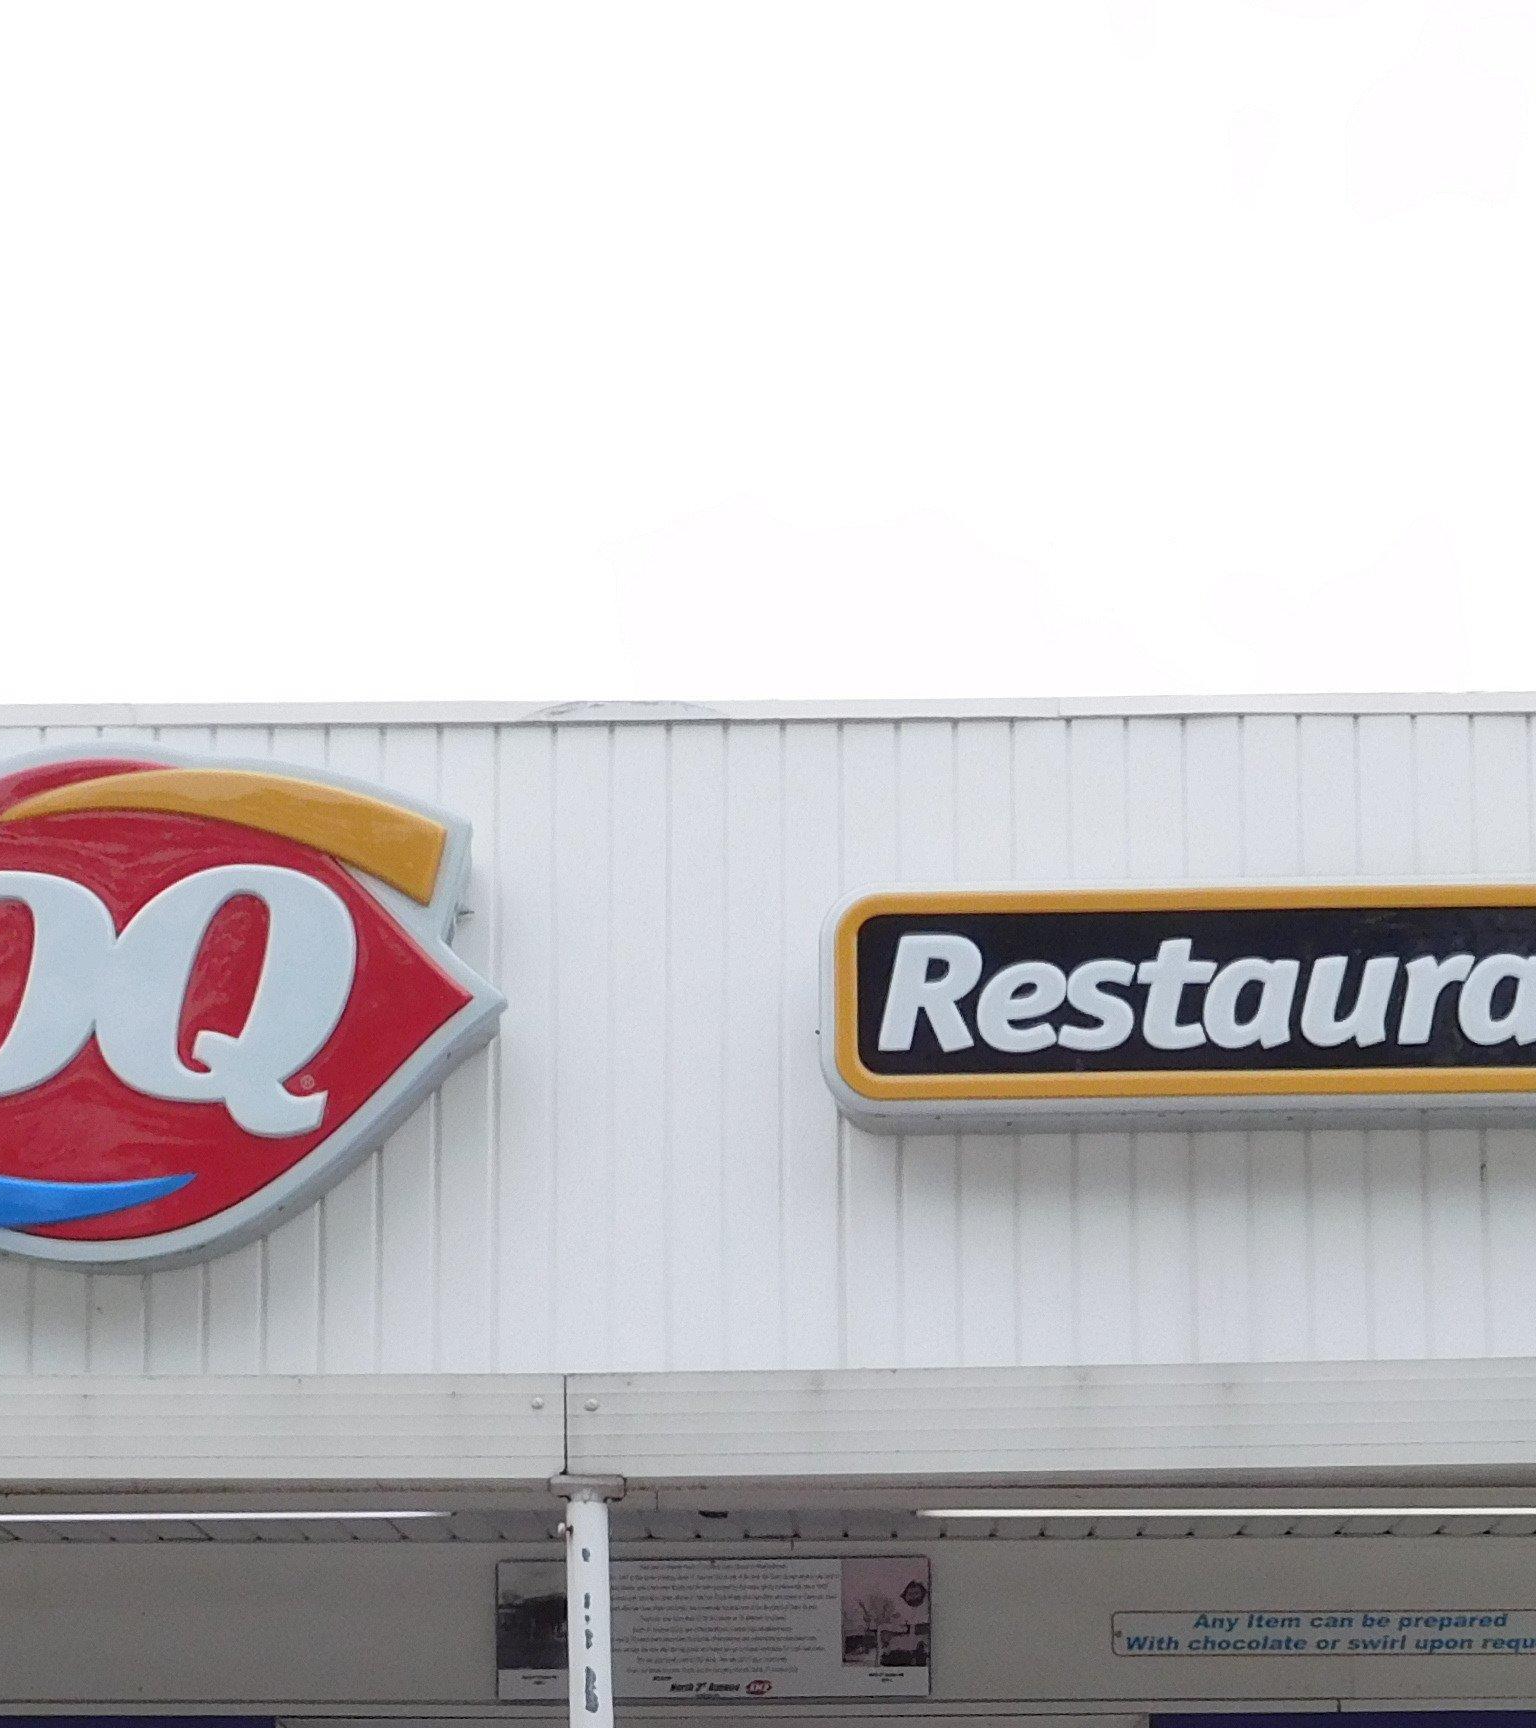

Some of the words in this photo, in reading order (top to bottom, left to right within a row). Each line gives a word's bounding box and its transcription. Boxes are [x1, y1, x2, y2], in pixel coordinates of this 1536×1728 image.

[1193, 1613, 1239, 1631] Any
[1310, 1615, 1354, 1628] can
[1362, 1614, 1390, 1628] be
[1398, 1613, 1508, 1631] prepared
[1126, 1636, 1180, 1650] With
[1187, 1635, 1307, 1650] chocolate
[1316, 1638, 1340, 1650] or
[1347, 1635, 1406, 1650] swirl
[1414, 1637, 1473, 1653] upon
